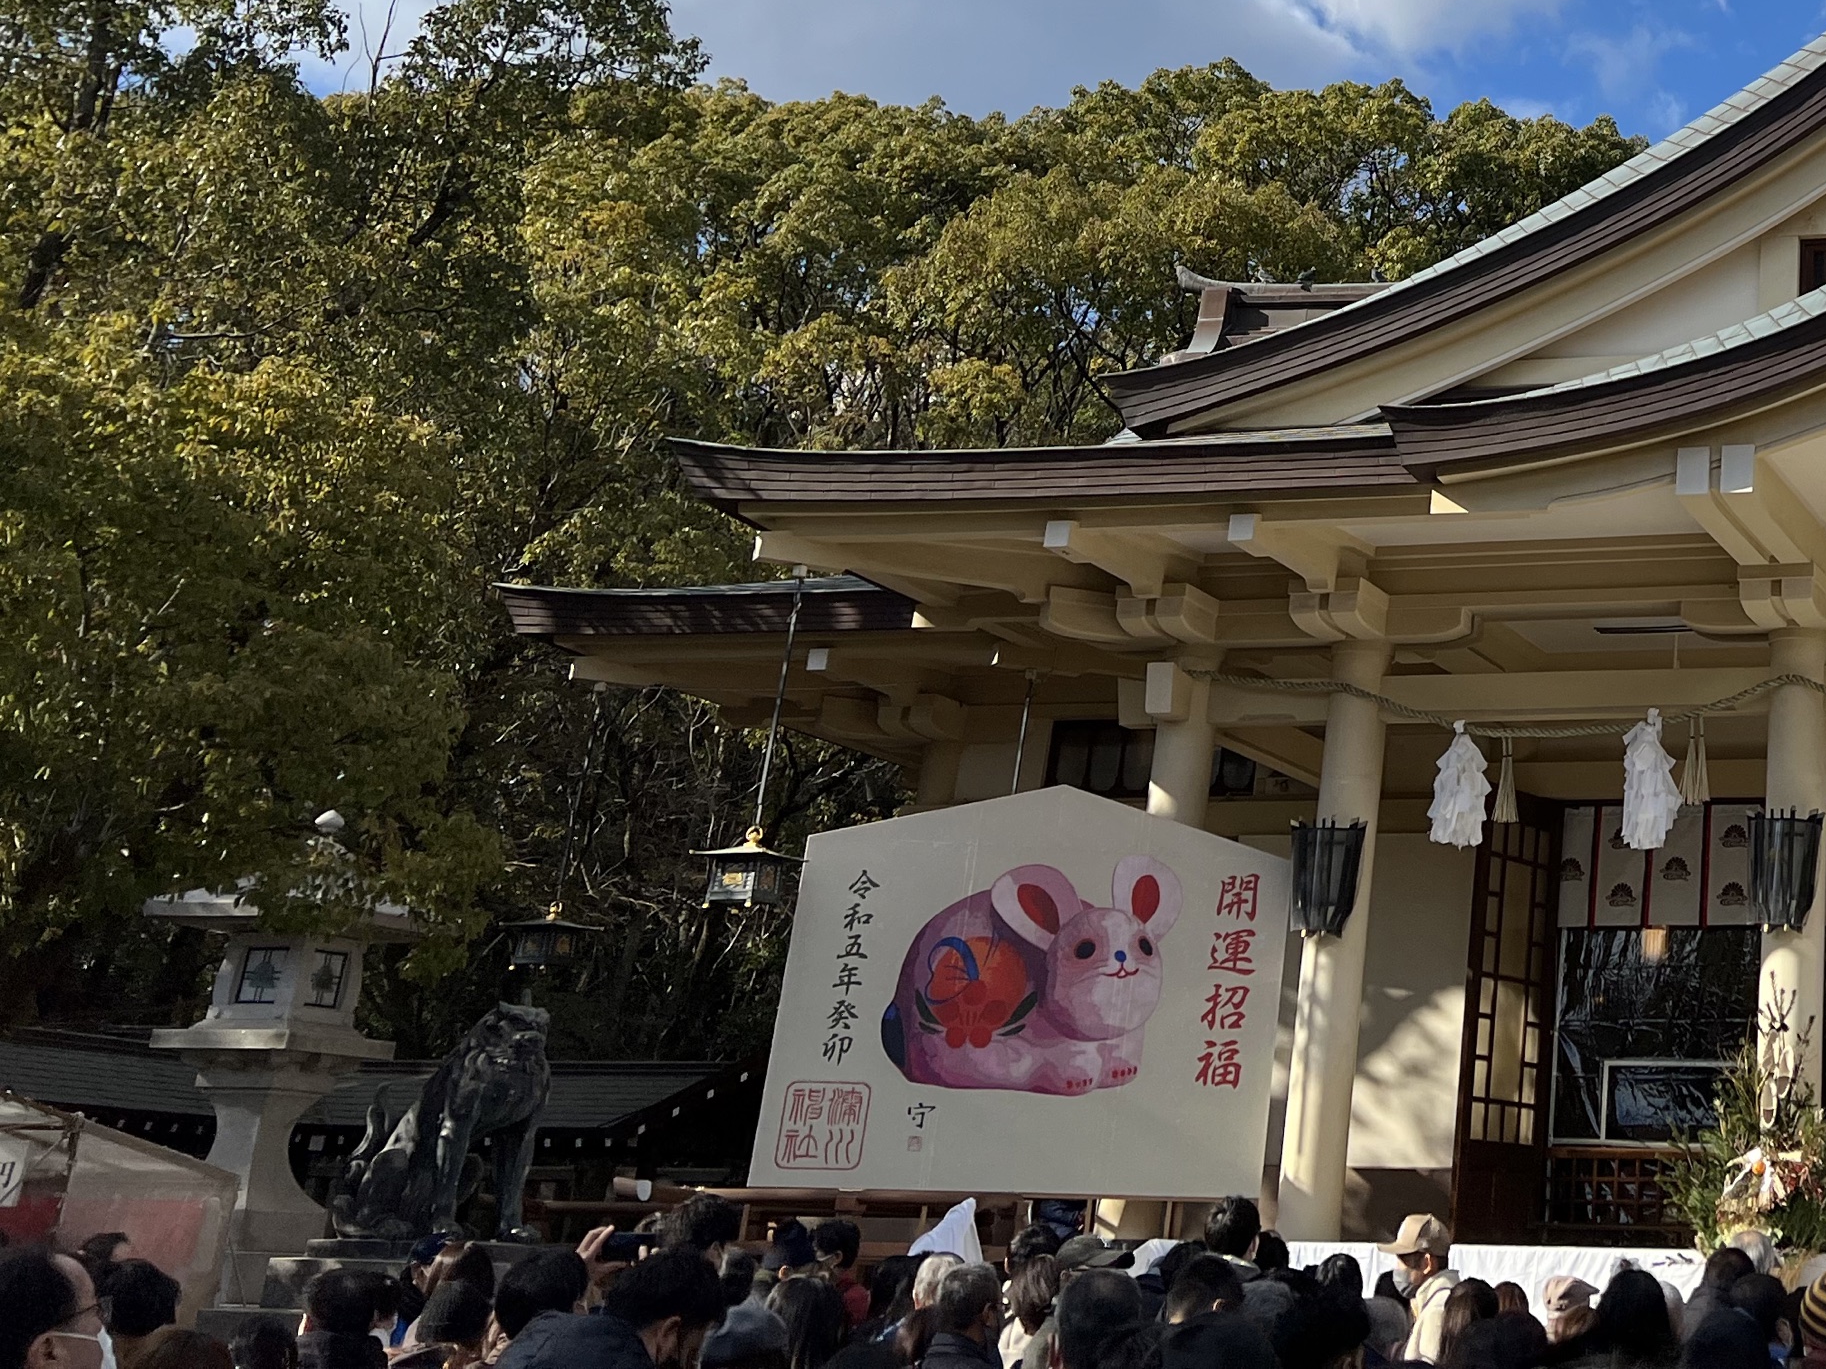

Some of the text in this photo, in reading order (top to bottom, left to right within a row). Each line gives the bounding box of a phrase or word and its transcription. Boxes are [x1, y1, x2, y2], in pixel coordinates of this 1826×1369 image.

[822, 869, 881, 1067] 令和五年癸卯
[1194, 873, 1261, 1090] 開運招福
